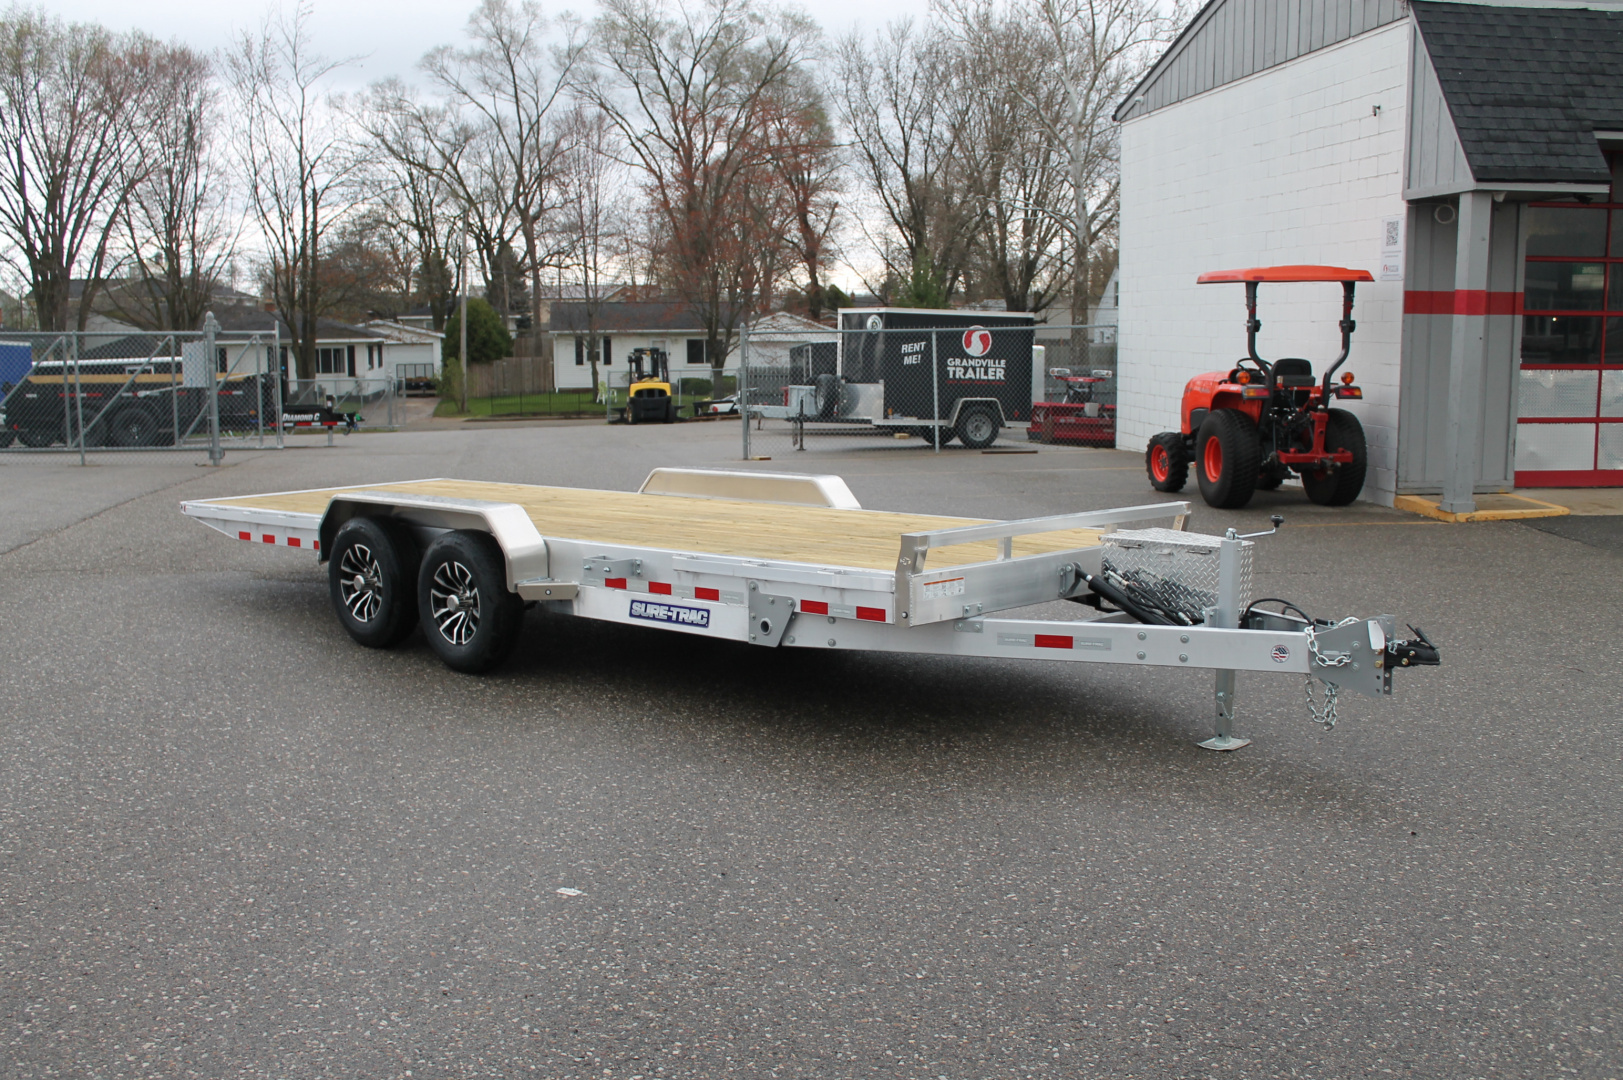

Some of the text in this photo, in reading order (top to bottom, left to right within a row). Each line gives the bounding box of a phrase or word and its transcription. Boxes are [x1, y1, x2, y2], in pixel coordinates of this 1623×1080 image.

[901, 341, 926, 354] RENT
[903, 354, 921, 365] ME!
[947, 358, 1006, 367] GRANDVILLE
[947, 367, 1005, 380] TRAILER
[314, 412, 320, 421] C
[631, 602, 708, 625] SURE-TRAC
